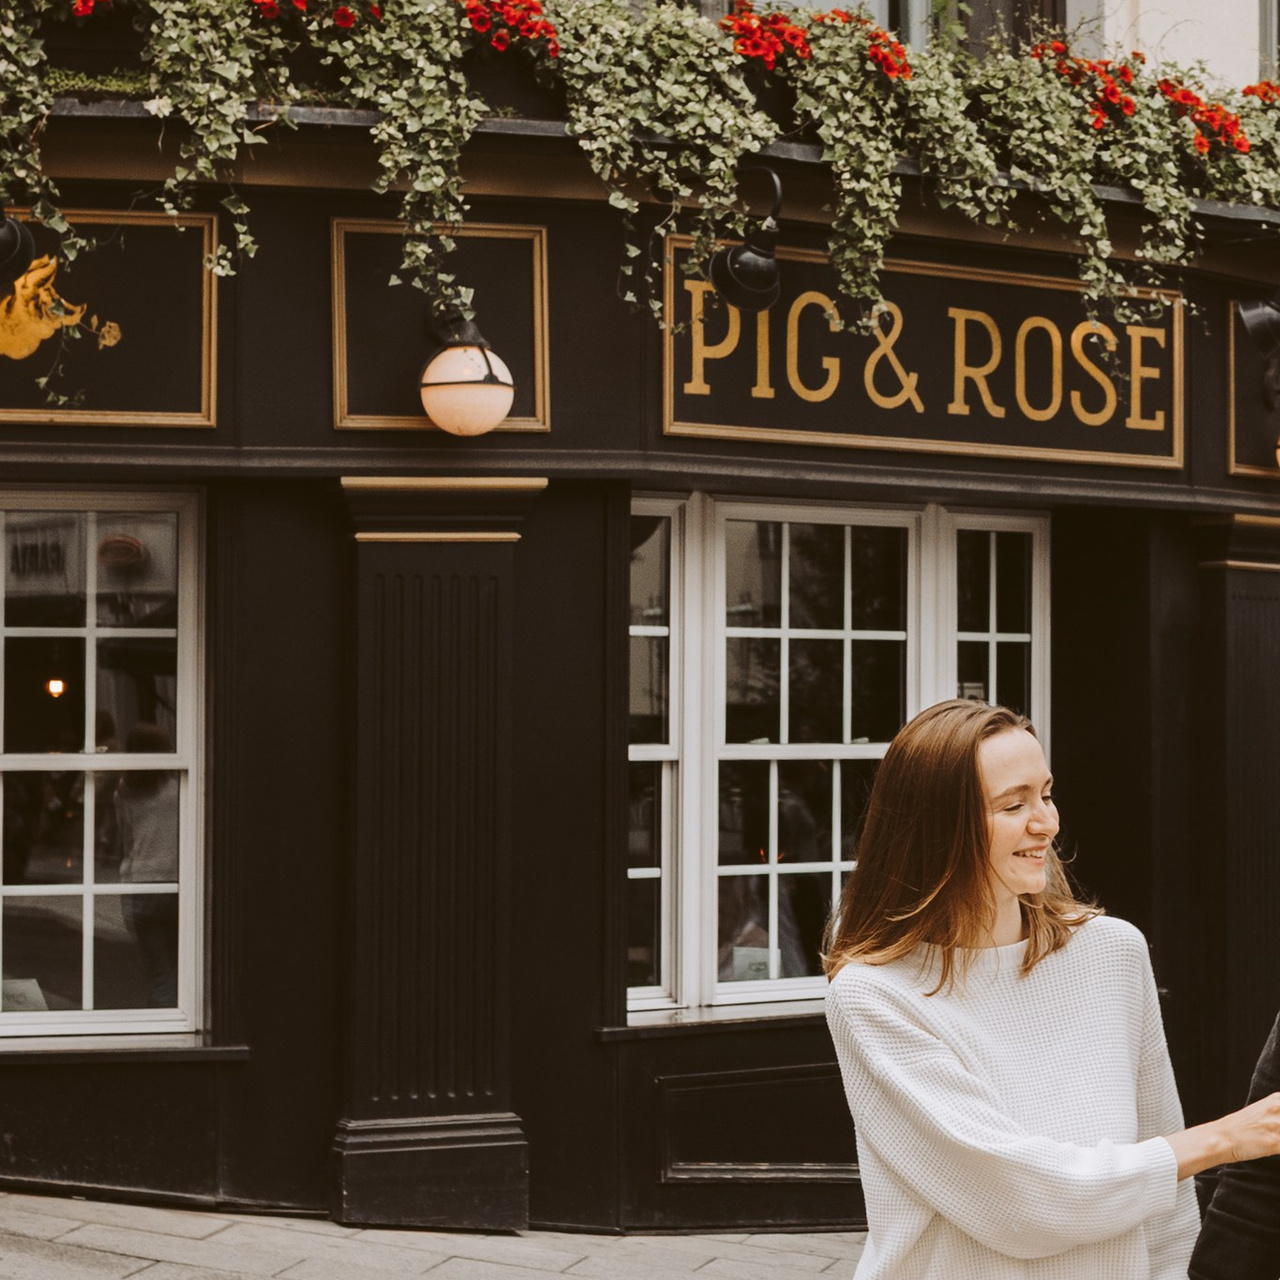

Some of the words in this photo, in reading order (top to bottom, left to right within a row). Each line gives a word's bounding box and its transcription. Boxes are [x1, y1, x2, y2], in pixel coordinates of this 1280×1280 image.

[683, 279, 842, 403] PIG
[864, 300, 925, 414] &
[947, 306, 1166, 431] ROSE
